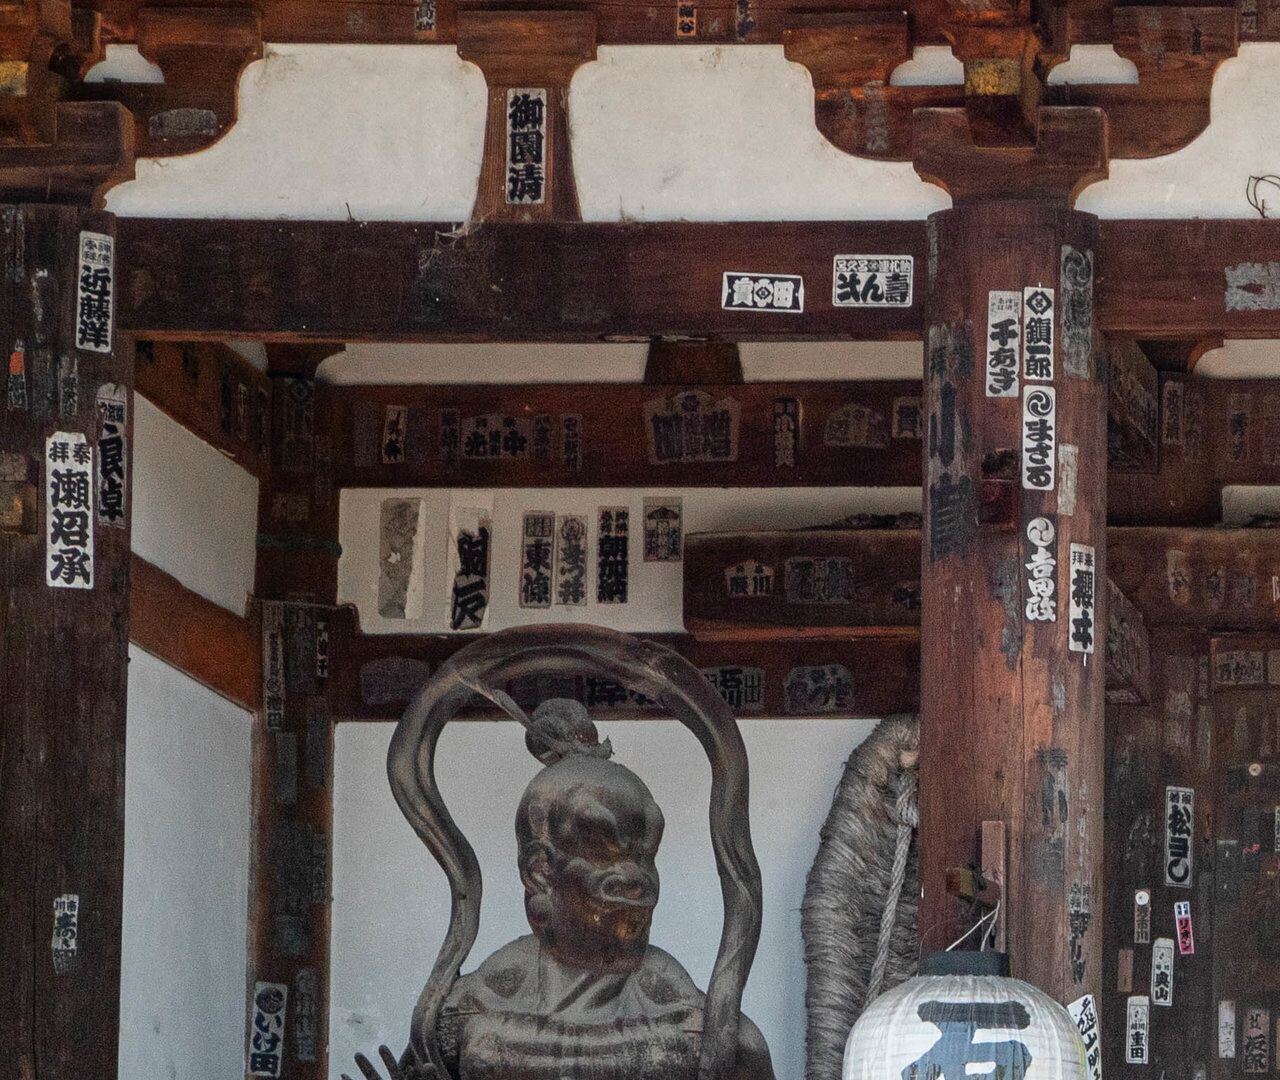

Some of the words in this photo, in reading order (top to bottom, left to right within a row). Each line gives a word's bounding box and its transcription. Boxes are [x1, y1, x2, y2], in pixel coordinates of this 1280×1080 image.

[1025, 419, 1054, 487] まさる
[51, 469, 91, 584] 瀬沼承
